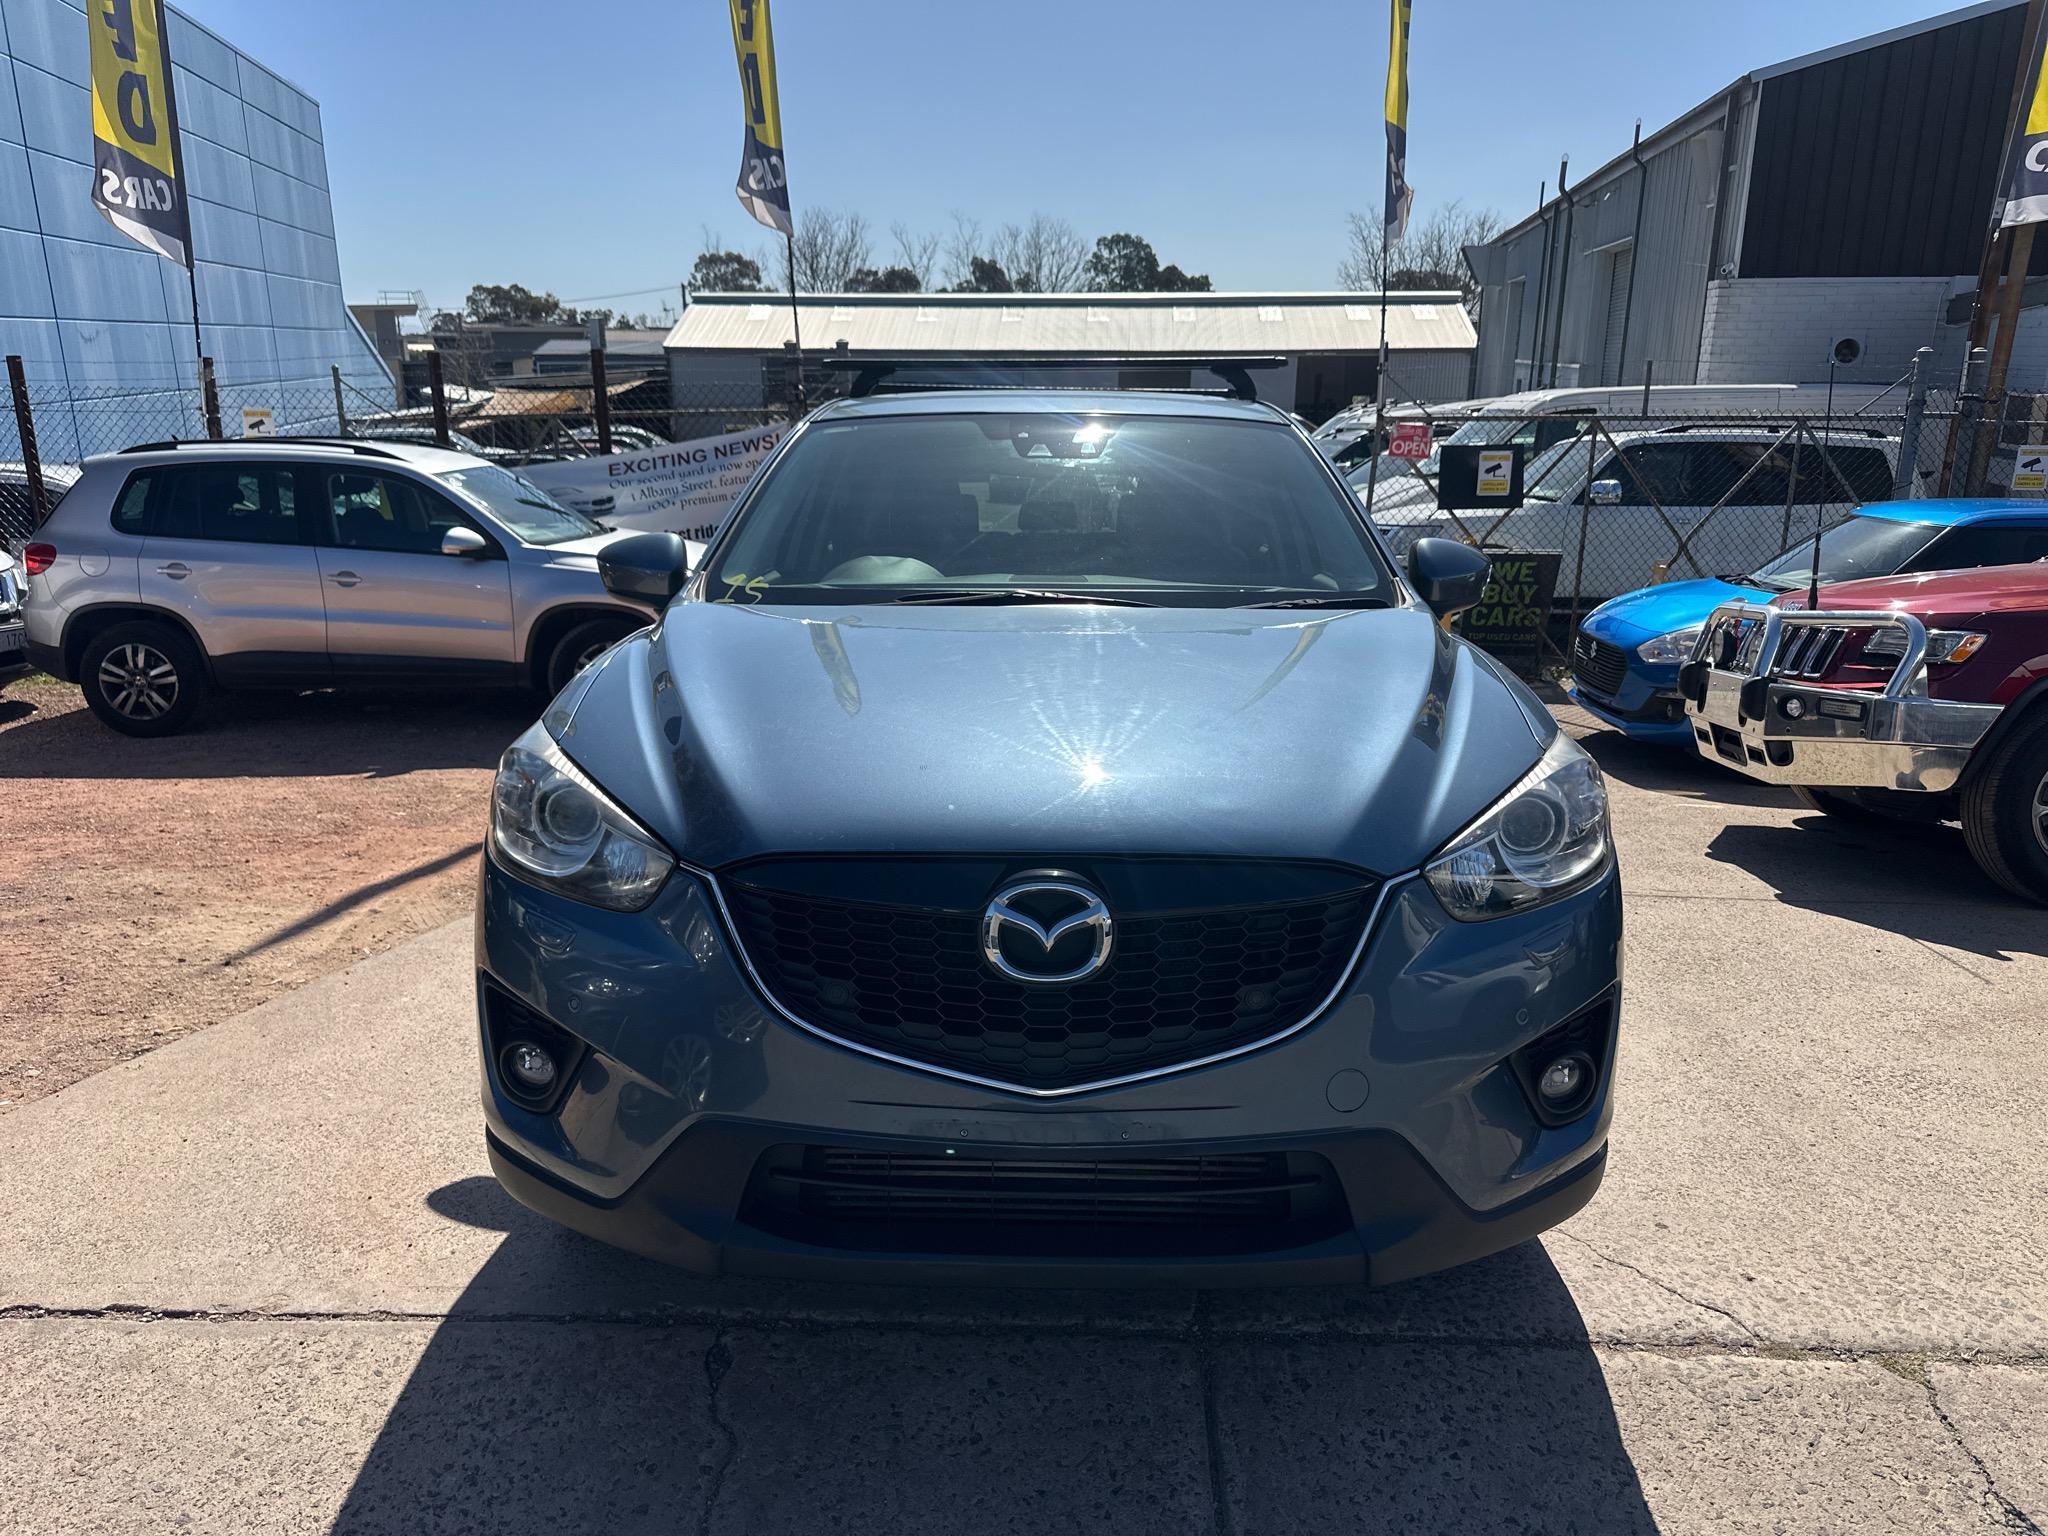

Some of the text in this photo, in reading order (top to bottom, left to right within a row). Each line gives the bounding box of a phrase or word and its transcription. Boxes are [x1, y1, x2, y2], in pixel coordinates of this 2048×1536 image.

[2024, 140, 2048, 172] C
[608, 432, 780, 477] EXCITING NEWS!
[1392, 440, 1430, 455] OPEN
[609, 478, 633, 490] Our
[636, 471, 676, 485] second
[678, 465, 704, 482] yard
[708, 464, 717, 473] is
[719, 462, 743, 472] now
[639, 486, 679, 500] Albany
[680, 492, 728, 510] premium
[1494, 561, 1537, 582] WE
[1482, 584, 1539, 604] BUY
[1470, 606, 1542, 627] CARS
